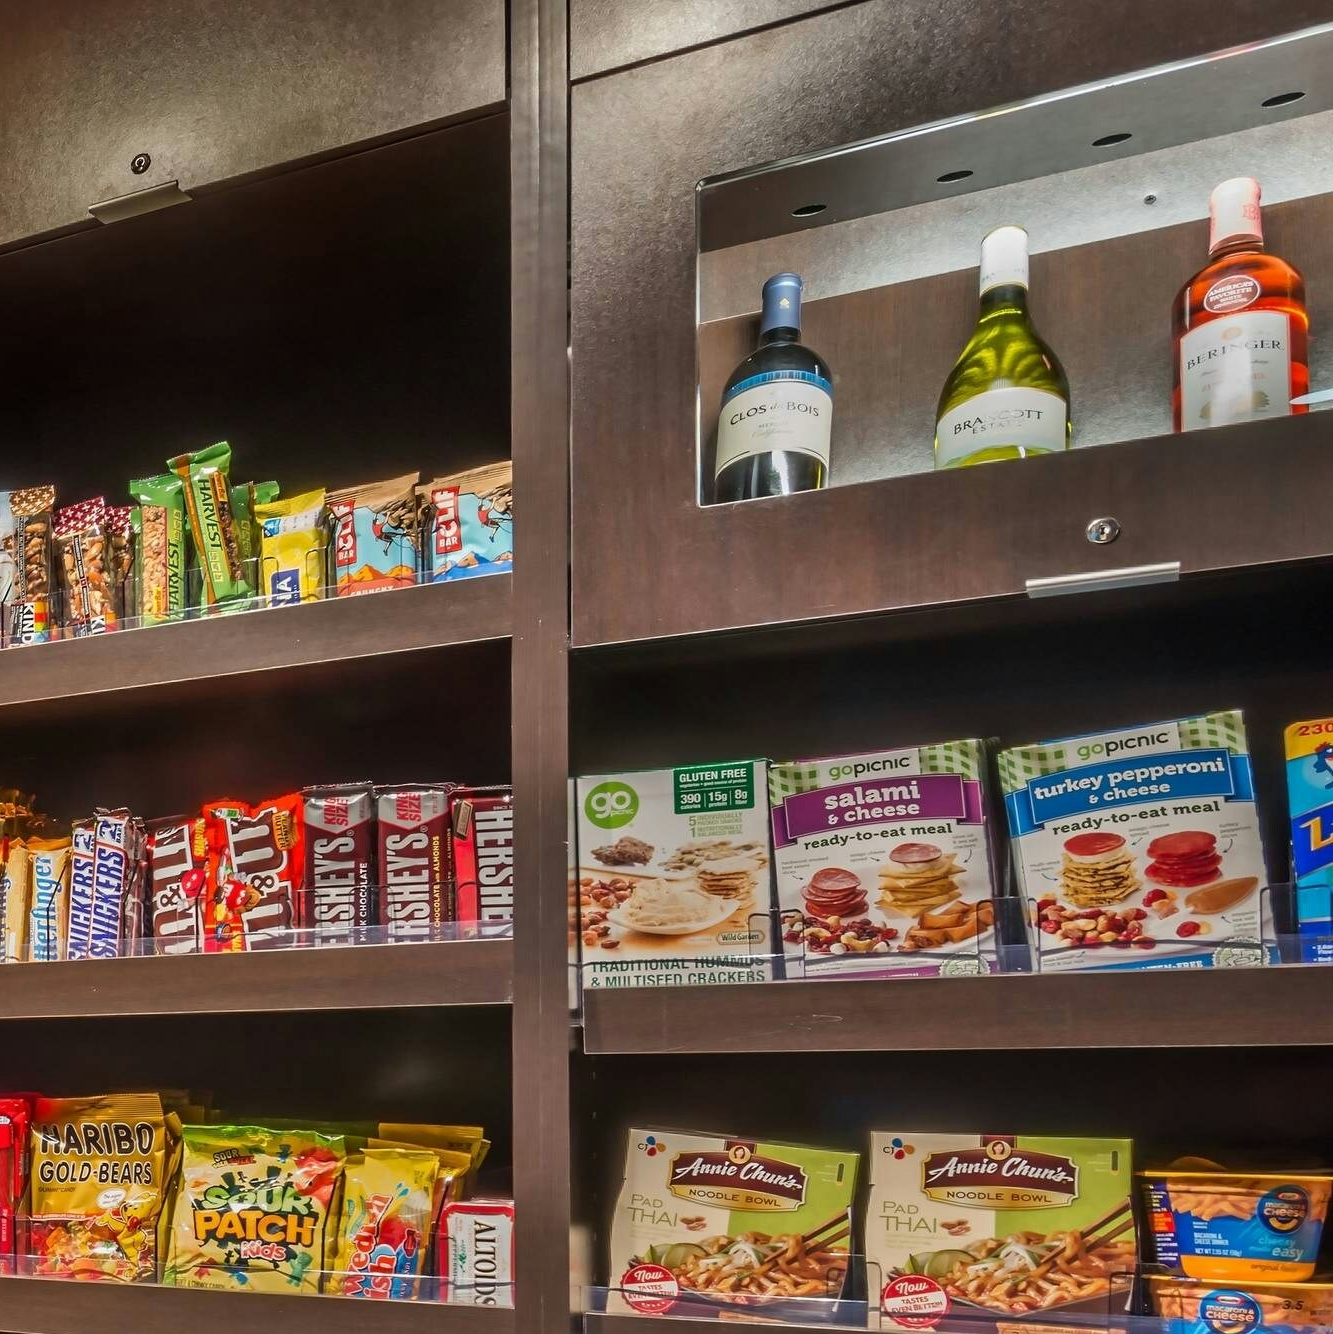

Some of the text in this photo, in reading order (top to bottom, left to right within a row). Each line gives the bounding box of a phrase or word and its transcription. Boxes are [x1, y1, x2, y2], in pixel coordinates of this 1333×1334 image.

[730, 404, 767, 425] CLOS
[787, 401, 819, 417] BOIS
[198, 479, 223, 551] HARVEST
[436, 491, 457, 535] CLIF
[439, 536, 458, 547] BAR
[338, 552, 354, 560] BAR
[169, 539, 182, 616] HARVEST
[23, 602, 34, 643] KIND
[679, 768, 746, 782] GLUTEN FREE
[1033, 757, 1225, 801] turkey pepperoni
[591, 790, 631, 819] go
[681, 793, 701, 804] 390
[709, 792, 727, 801] 15g
[735, 789, 747, 799] 8g
[824, 781, 921, 810] salami
[1088, 783, 1171, 804] & cheese
[323, 797, 337, 825] KING
[337, 797, 348, 826] SIZE
[396, 792, 409, 820] KING
[409, 793, 421, 822] SIZE
[828, 803, 920, 826] & cheese
[1052, 806, 1167, 836] ready-to-eat
[1172, 800, 1222, 816] meal
[804, 823, 953, 850] ready-to-eat meal
[89, 848, 124, 957] SNICKERS
[737, 933, 760, 941] Garden
[591, 958, 689, 973] TRADITIONAL
[591, 977, 600, 987] &
[688, 970, 765, 984] CRACKERS
[41, 1122, 155, 1155] HARIBO
[637, 1142, 648, 1152] CJ
[213, 1148, 239, 1163] SOUR
[883, 1145, 894, 1155] CJ
[40, 1160, 153, 1184] GOLD-BEARS
[675, 1158, 802, 1189] Annie Chun's
[926, 1156, 1074, 1183] Annie Chun's
[202, 1184, 312, 1215] SOUR
[689, 1189, 782, 1207] NOODLE BOWL
[946, 1190, 1052, 1202] NOODLE BOWL
[195, 1210, 315, 1246] PATCH
[628, 1208, 678, 1226] THAI
[879, 1215, 937, 1233] THAI
[240, 1240, 286, 1260] Kids
[1271, 1245, 1304, 1260] easy
[474, 1219, 497, 1306] ALTOIDS
[634, 1270, 663, 1282] Now
[895, 1282, 928, 1294] Now
[902, 1296, 928, 1304] TASTES
[1283, 1300, 1304, 1310] 3.5
